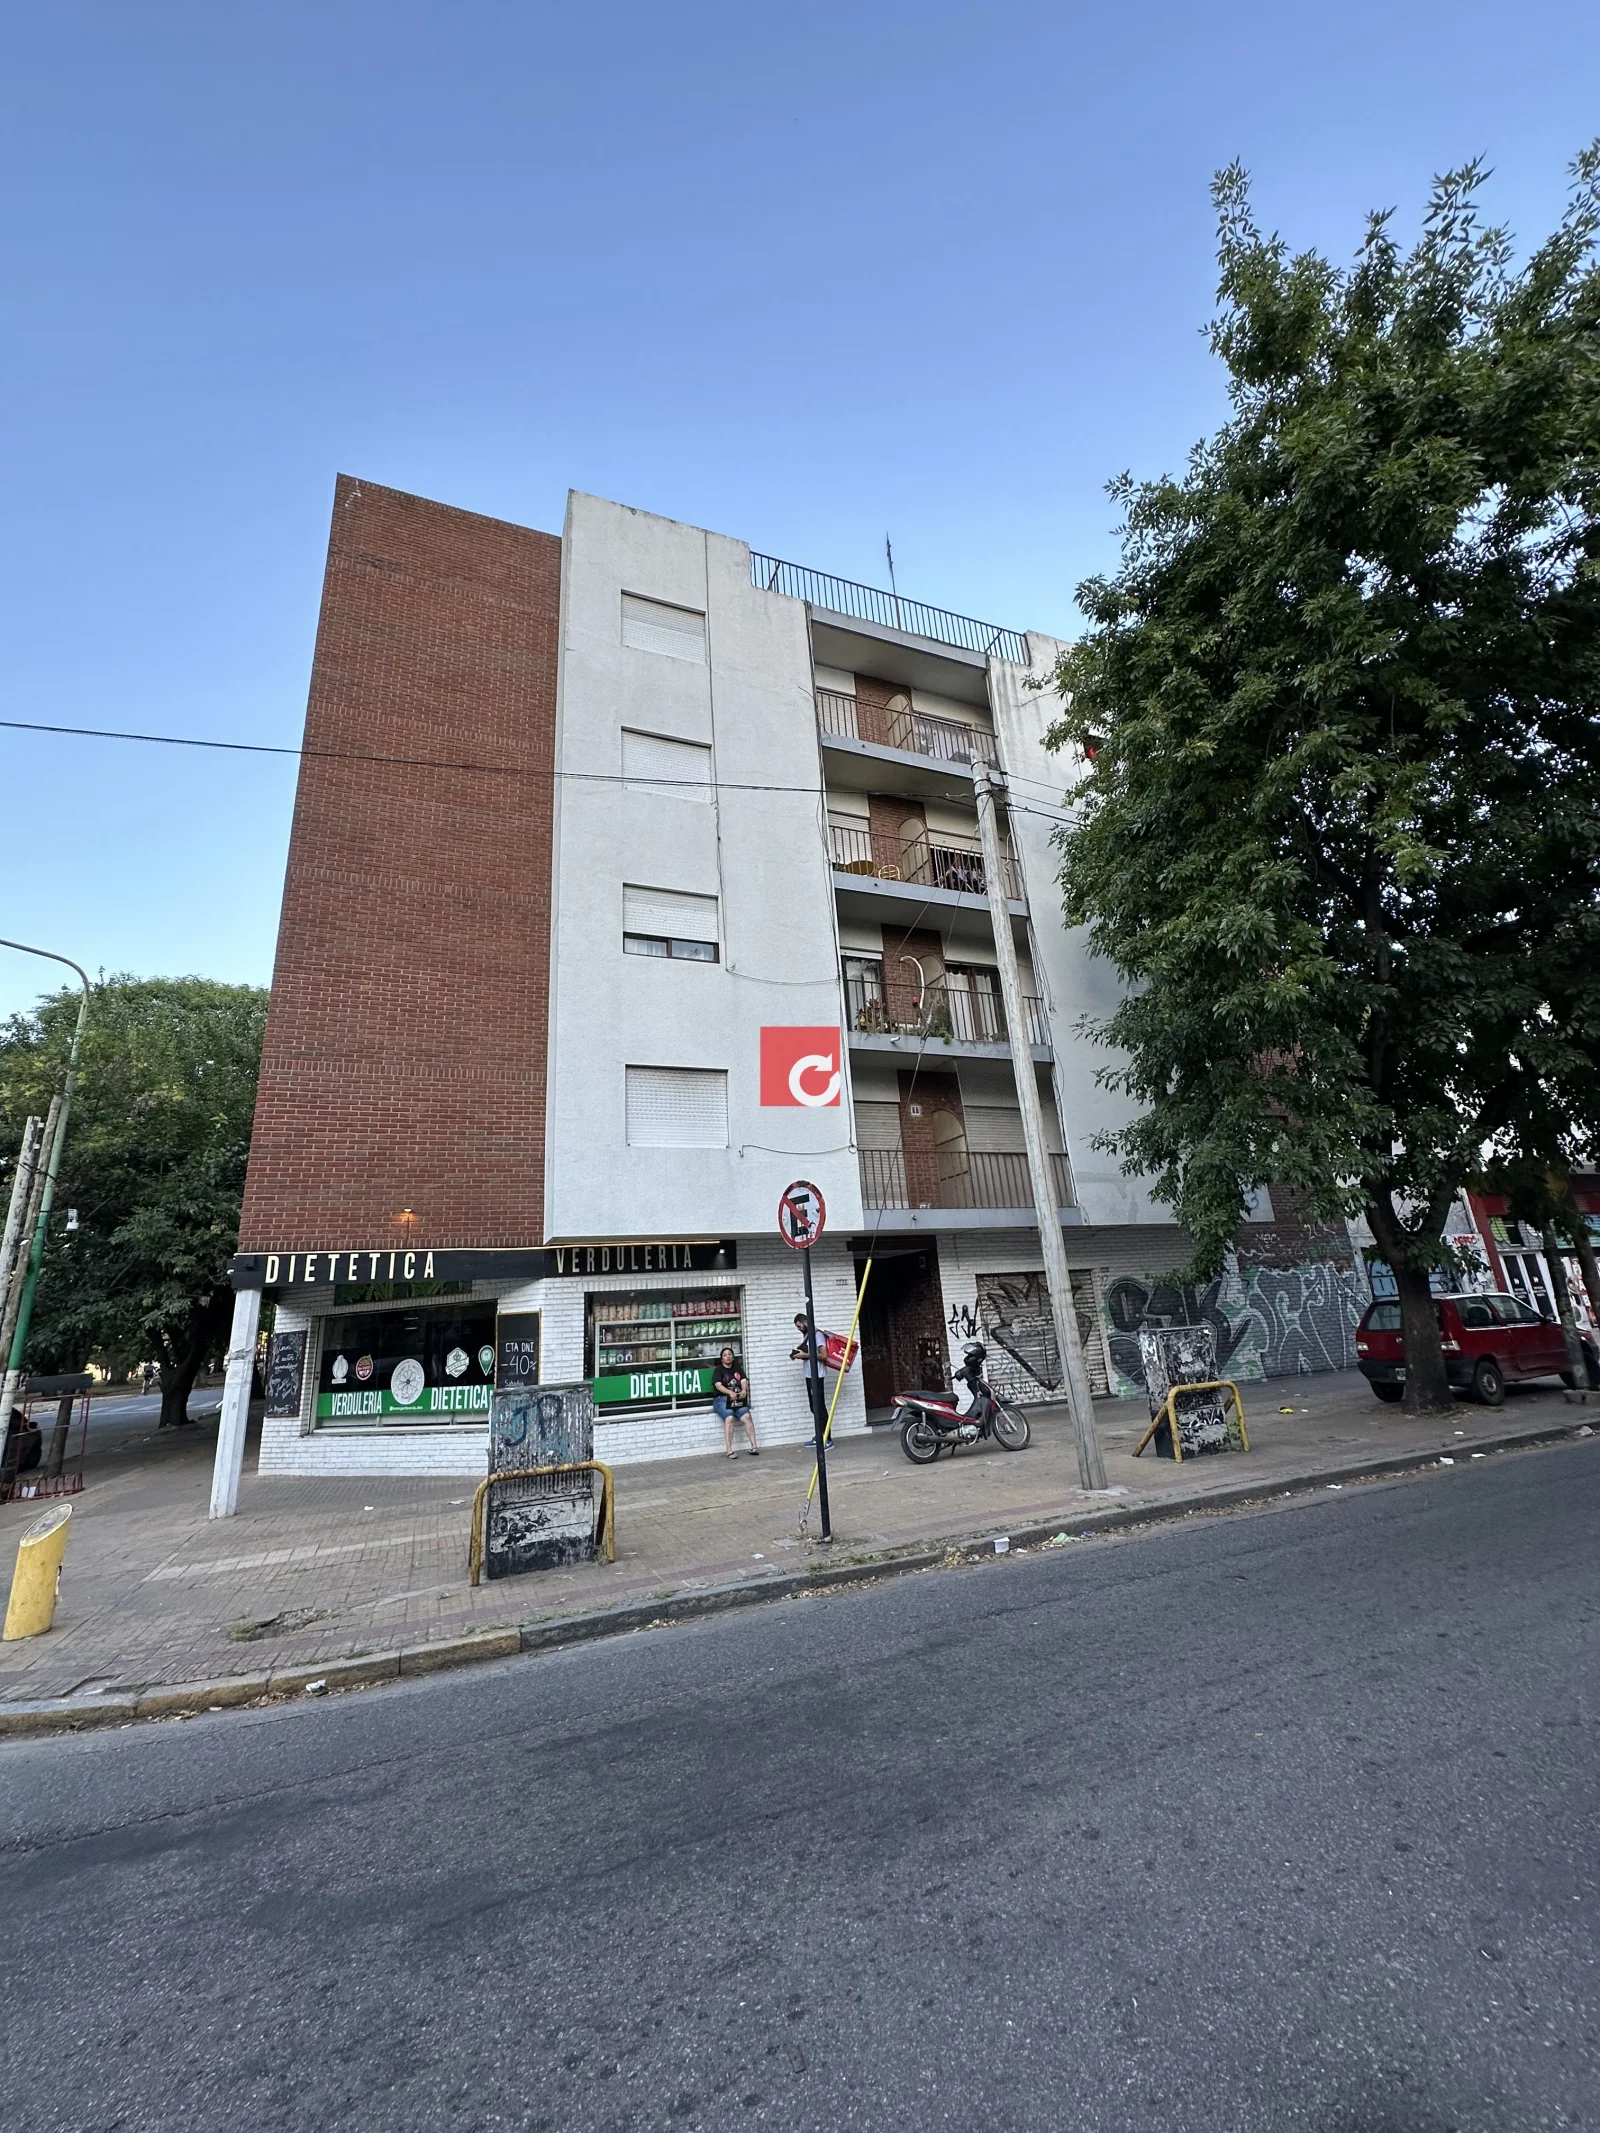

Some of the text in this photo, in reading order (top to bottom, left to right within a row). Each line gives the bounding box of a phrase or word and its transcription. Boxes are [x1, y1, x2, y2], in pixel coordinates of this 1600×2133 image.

[265, 1252, 434, 1284] DIETETICA
[556, 1245, 692, 1274] VERDULERIA
[521, 1341, 535, 1353] DNI
[500, 1354, 537, 1375] -40%
[430, 1384, 488, 1411] DIETETICA
[630, 1369, 702, 1399] DIETETICA
[331, 1390, 382, 1416] VERDULERIA
